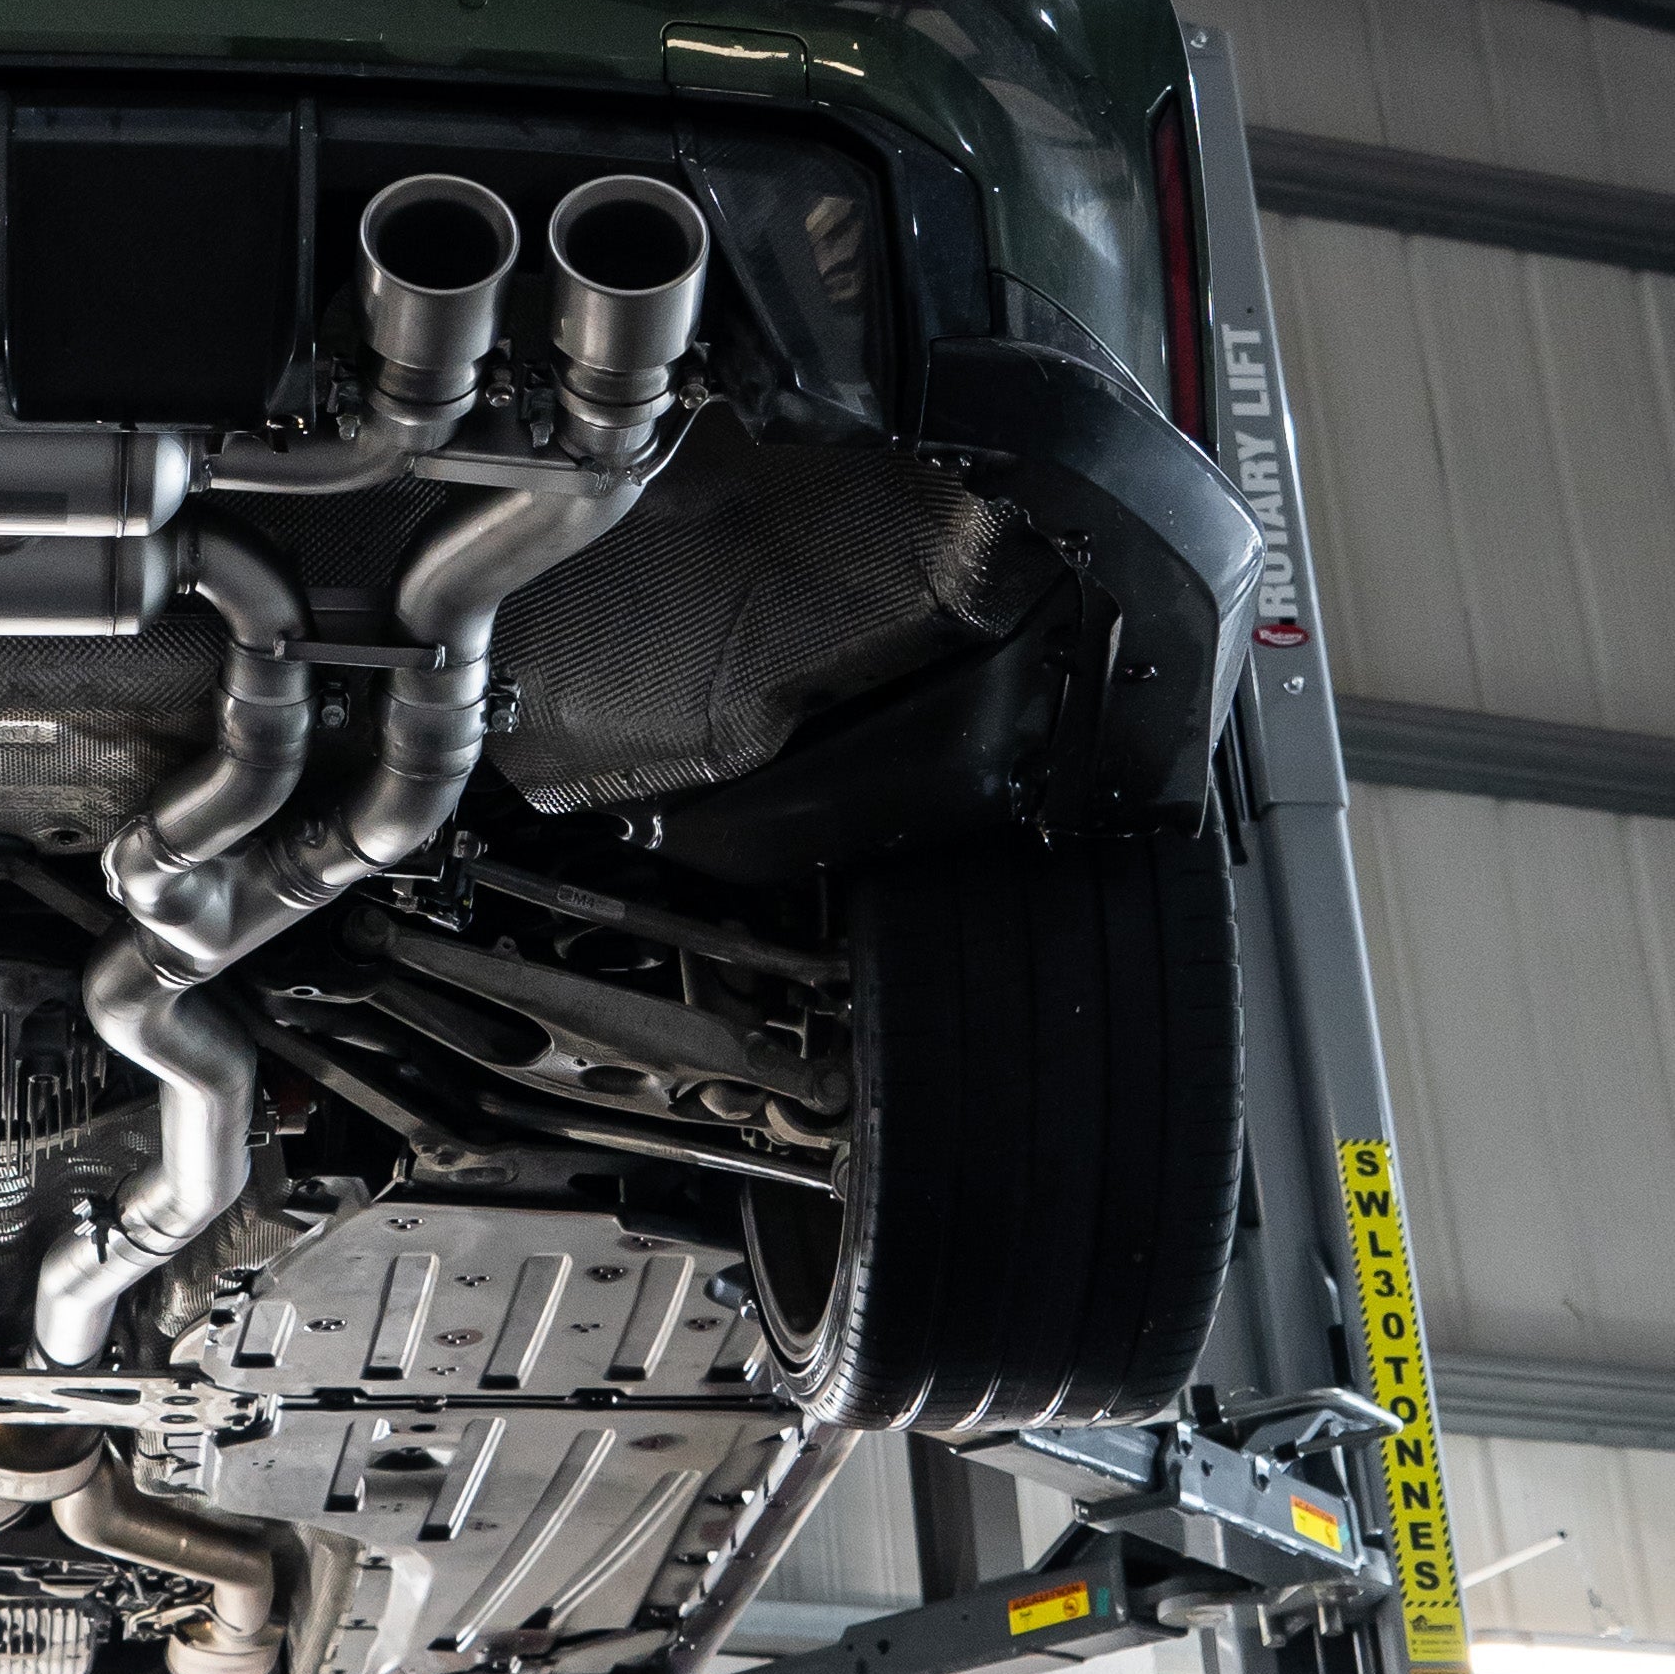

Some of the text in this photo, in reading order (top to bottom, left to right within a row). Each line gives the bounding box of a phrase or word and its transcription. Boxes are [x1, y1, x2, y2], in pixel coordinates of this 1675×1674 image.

[1222, 324, 1272, 417] LIFT
[1355, 1150, 1393, 1258] SWL
[1385, 1356, 1441, 1592] TONNES
